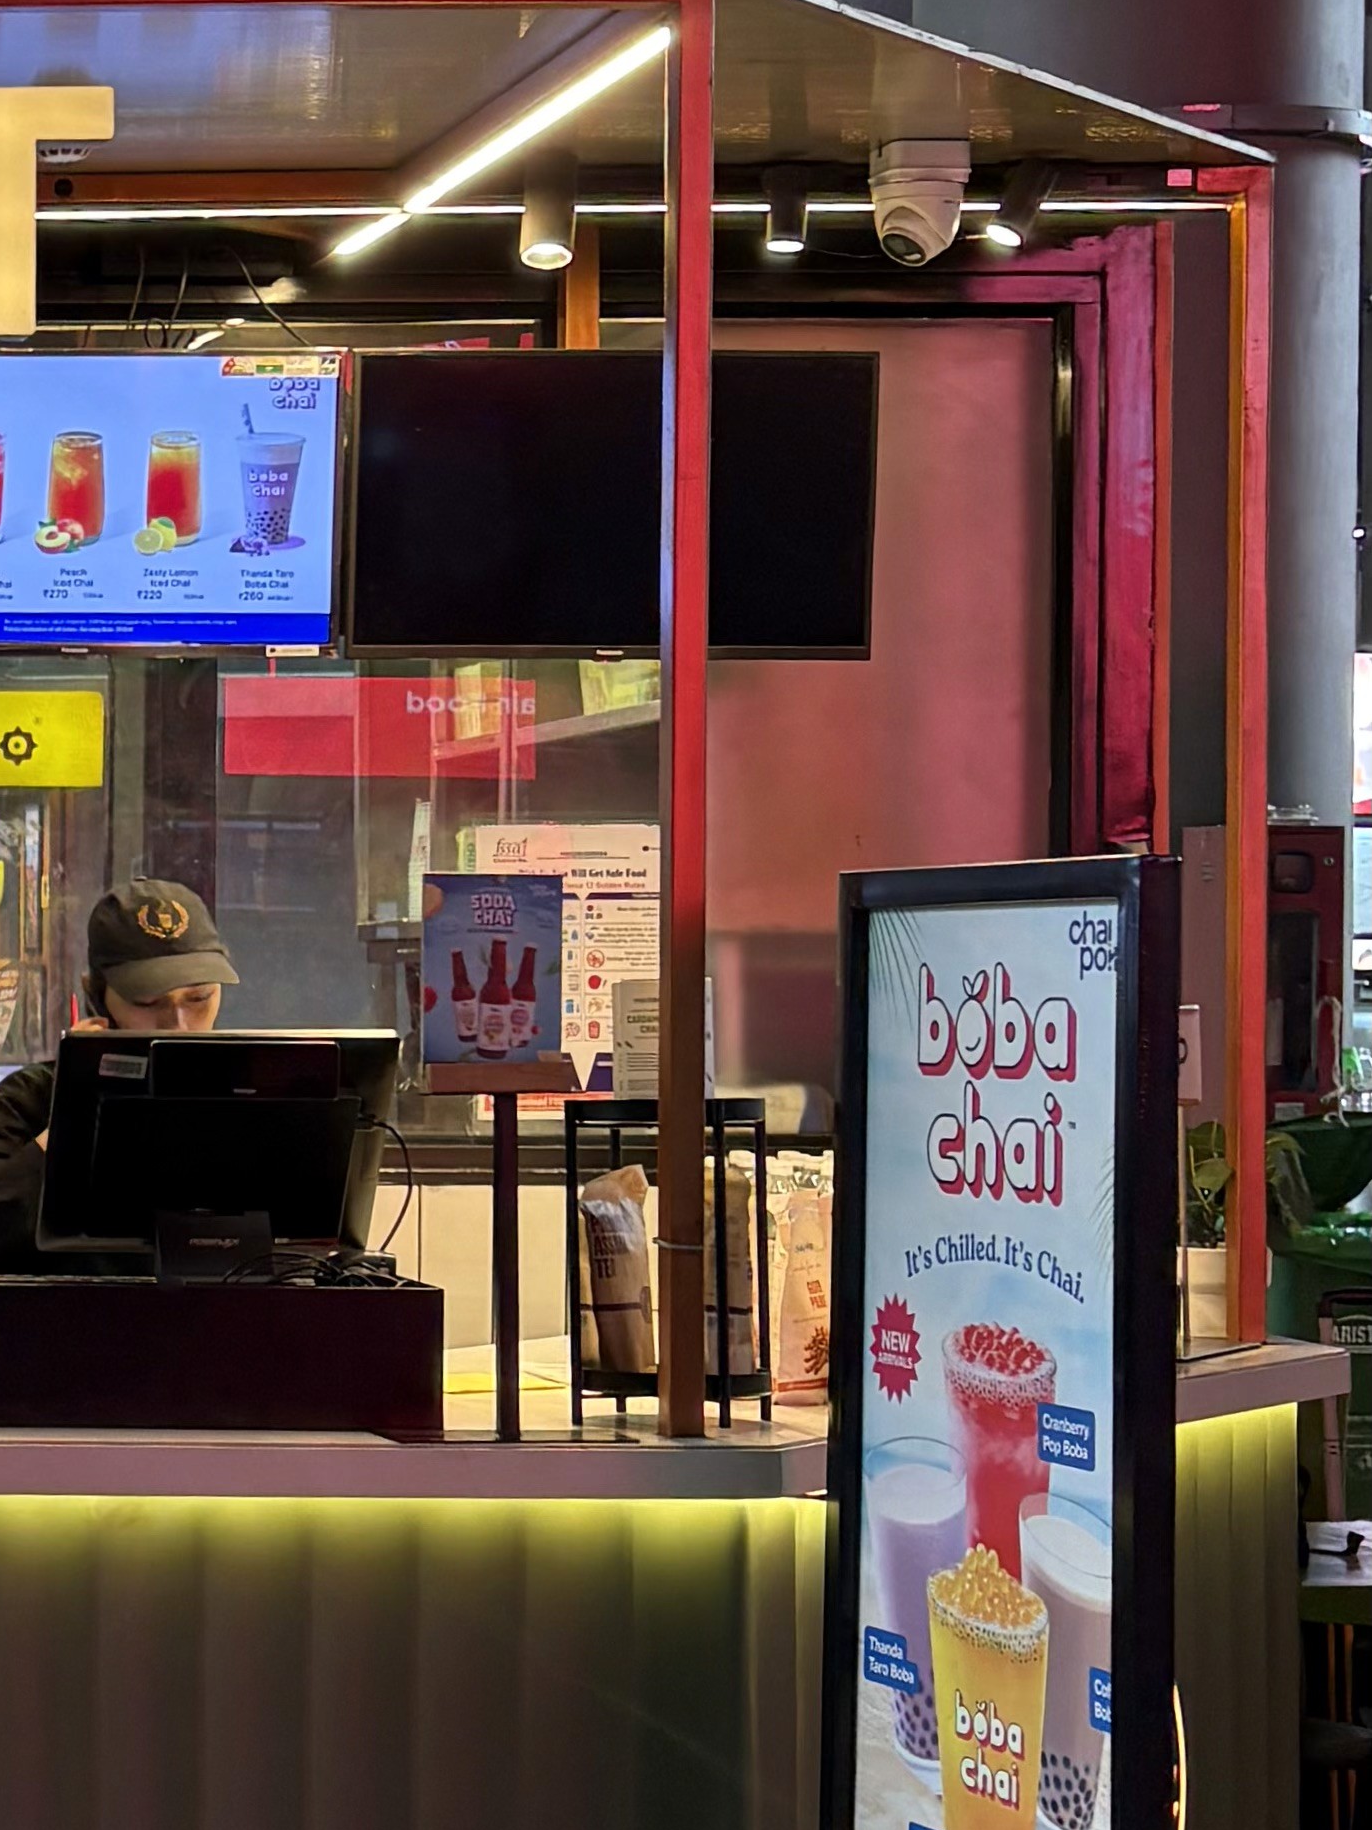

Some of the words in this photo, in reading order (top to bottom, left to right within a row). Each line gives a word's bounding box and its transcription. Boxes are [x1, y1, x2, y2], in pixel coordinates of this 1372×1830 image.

[272, 390, 316, 410] chai
[248, 469, 289, 484] boba
[471, 894, 517, 912] SODA
[1068, 910, 1113, 946] chai
[918, 961, 1078, 1083] boba
[925, 1079, 1063, 1208] chai
[905, 1244, 933, 1279] It's
[935, 1233, 1001, 1265] Chilled.
[1004, 1236, 1033, 1273] It's
[1037, 1250, 1085, 1304] Chai.
[880, 1328, 911, 1353] NEW
[877, 1352, 914, 1370] ARRIVALS
[1042, 1412, 1090, 1441] Cranberry
[1042, 1435, 1062, 1457] Pop
[1062, 1439, 1089, 1460] Boba
[868, 1635, 904, 1660] Thanda
[868, 1656, 890, 1678] Taro
[890, 1661, 915, 1685] Boba
[955, 1688, 1025, 1761] boba
[959, 1746, 1020, 1811] chai
